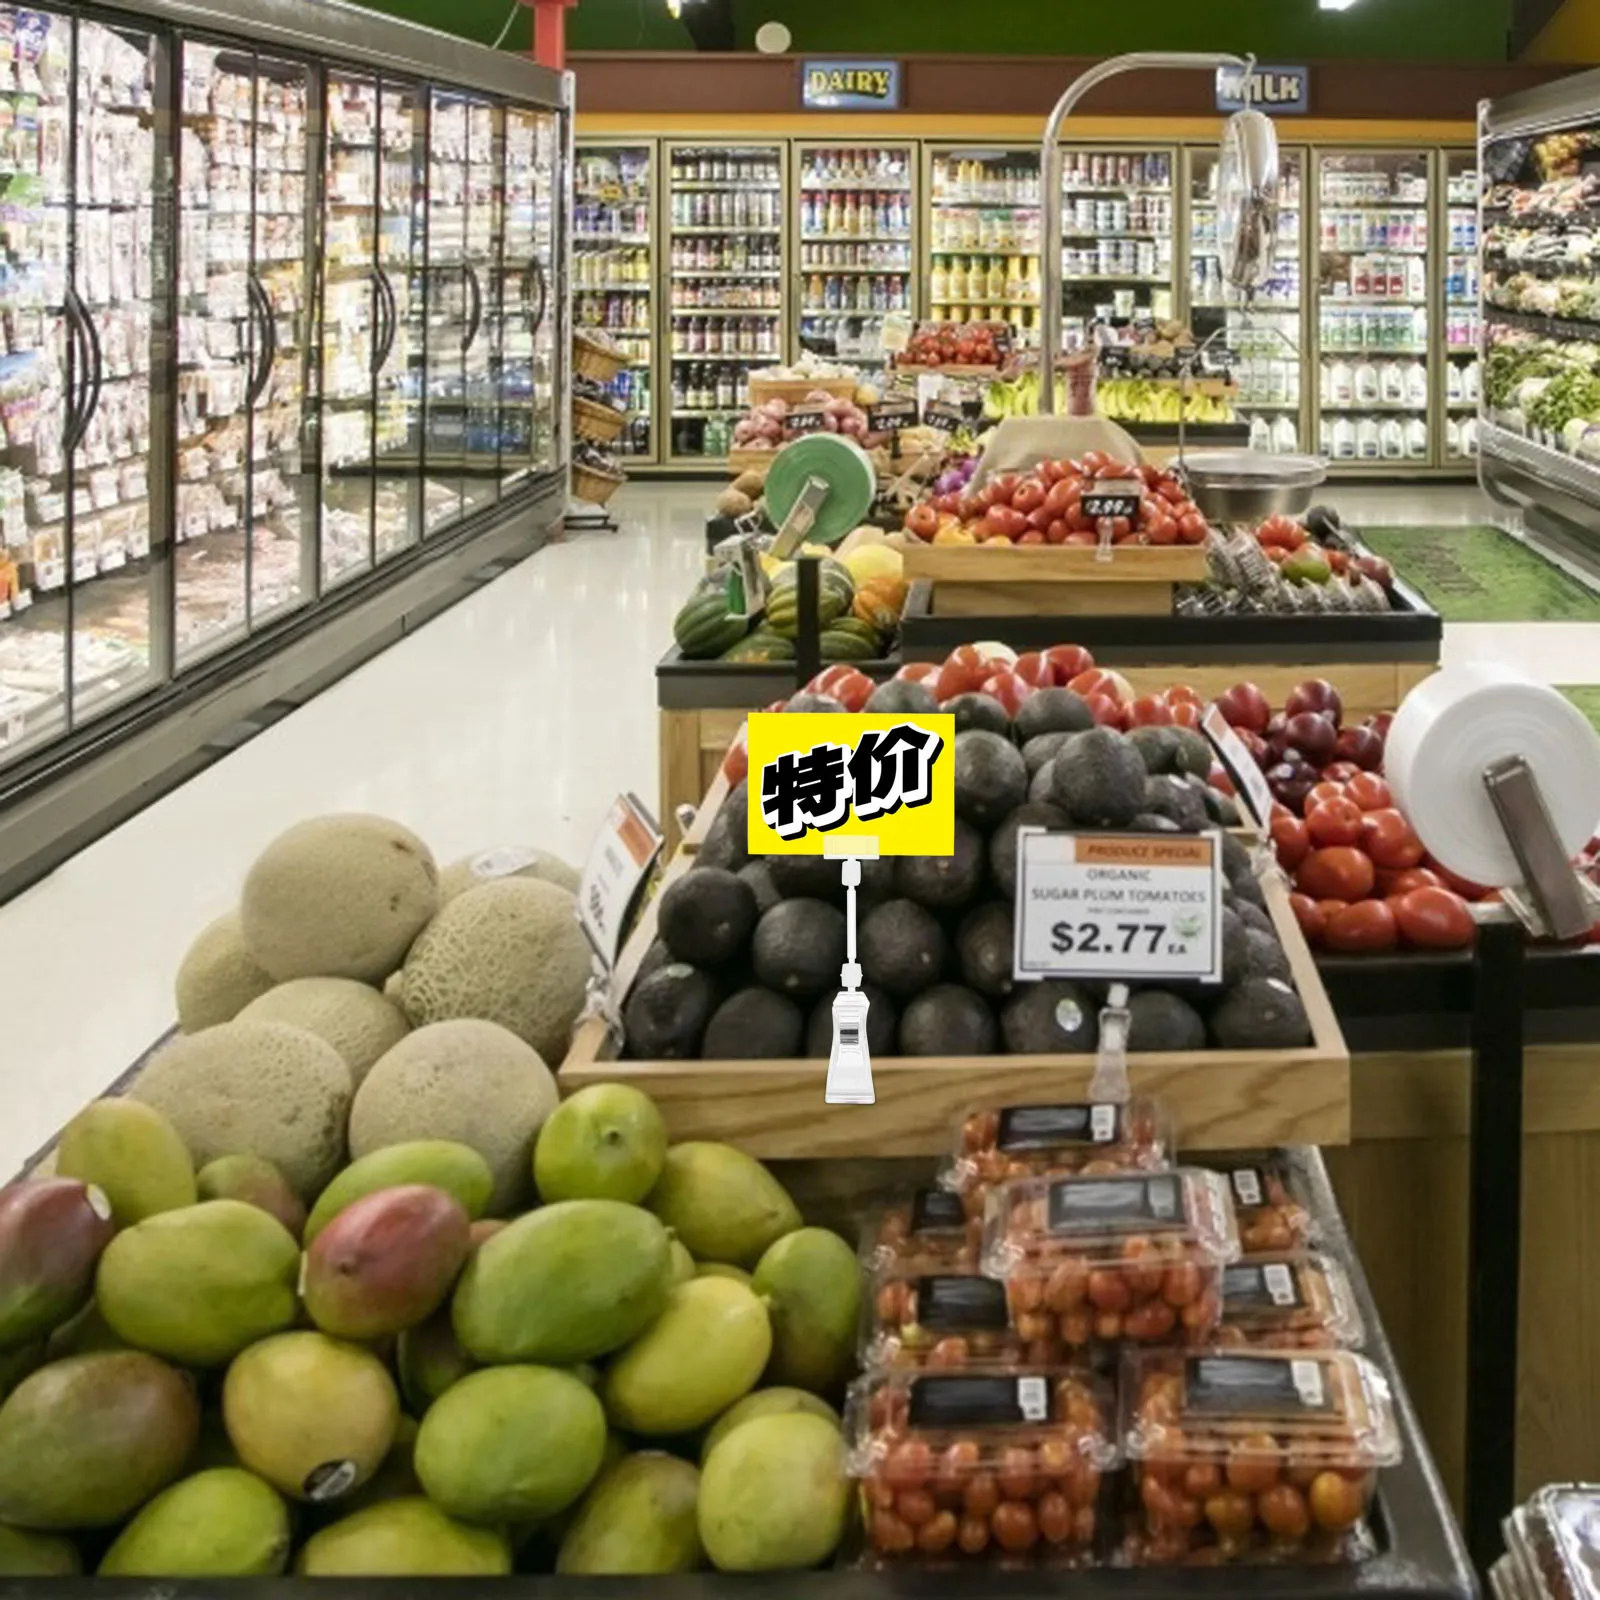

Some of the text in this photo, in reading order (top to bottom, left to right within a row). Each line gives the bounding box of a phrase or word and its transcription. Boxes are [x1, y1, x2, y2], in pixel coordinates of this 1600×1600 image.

[809, 69, 890, 97] DAIRY
[1222, 73, 1301, 102] MILK
[761, 723, 943, 840] 特价
[1087, 844, 1200, 859] PRODUCE SPECIAL
[1086, 868, 1152, 882] ORGANIC
[1031, 887, 1207, 903] SUGAR PLUM TOMATOES
[1051, 919, 1167, 956] $2.77
